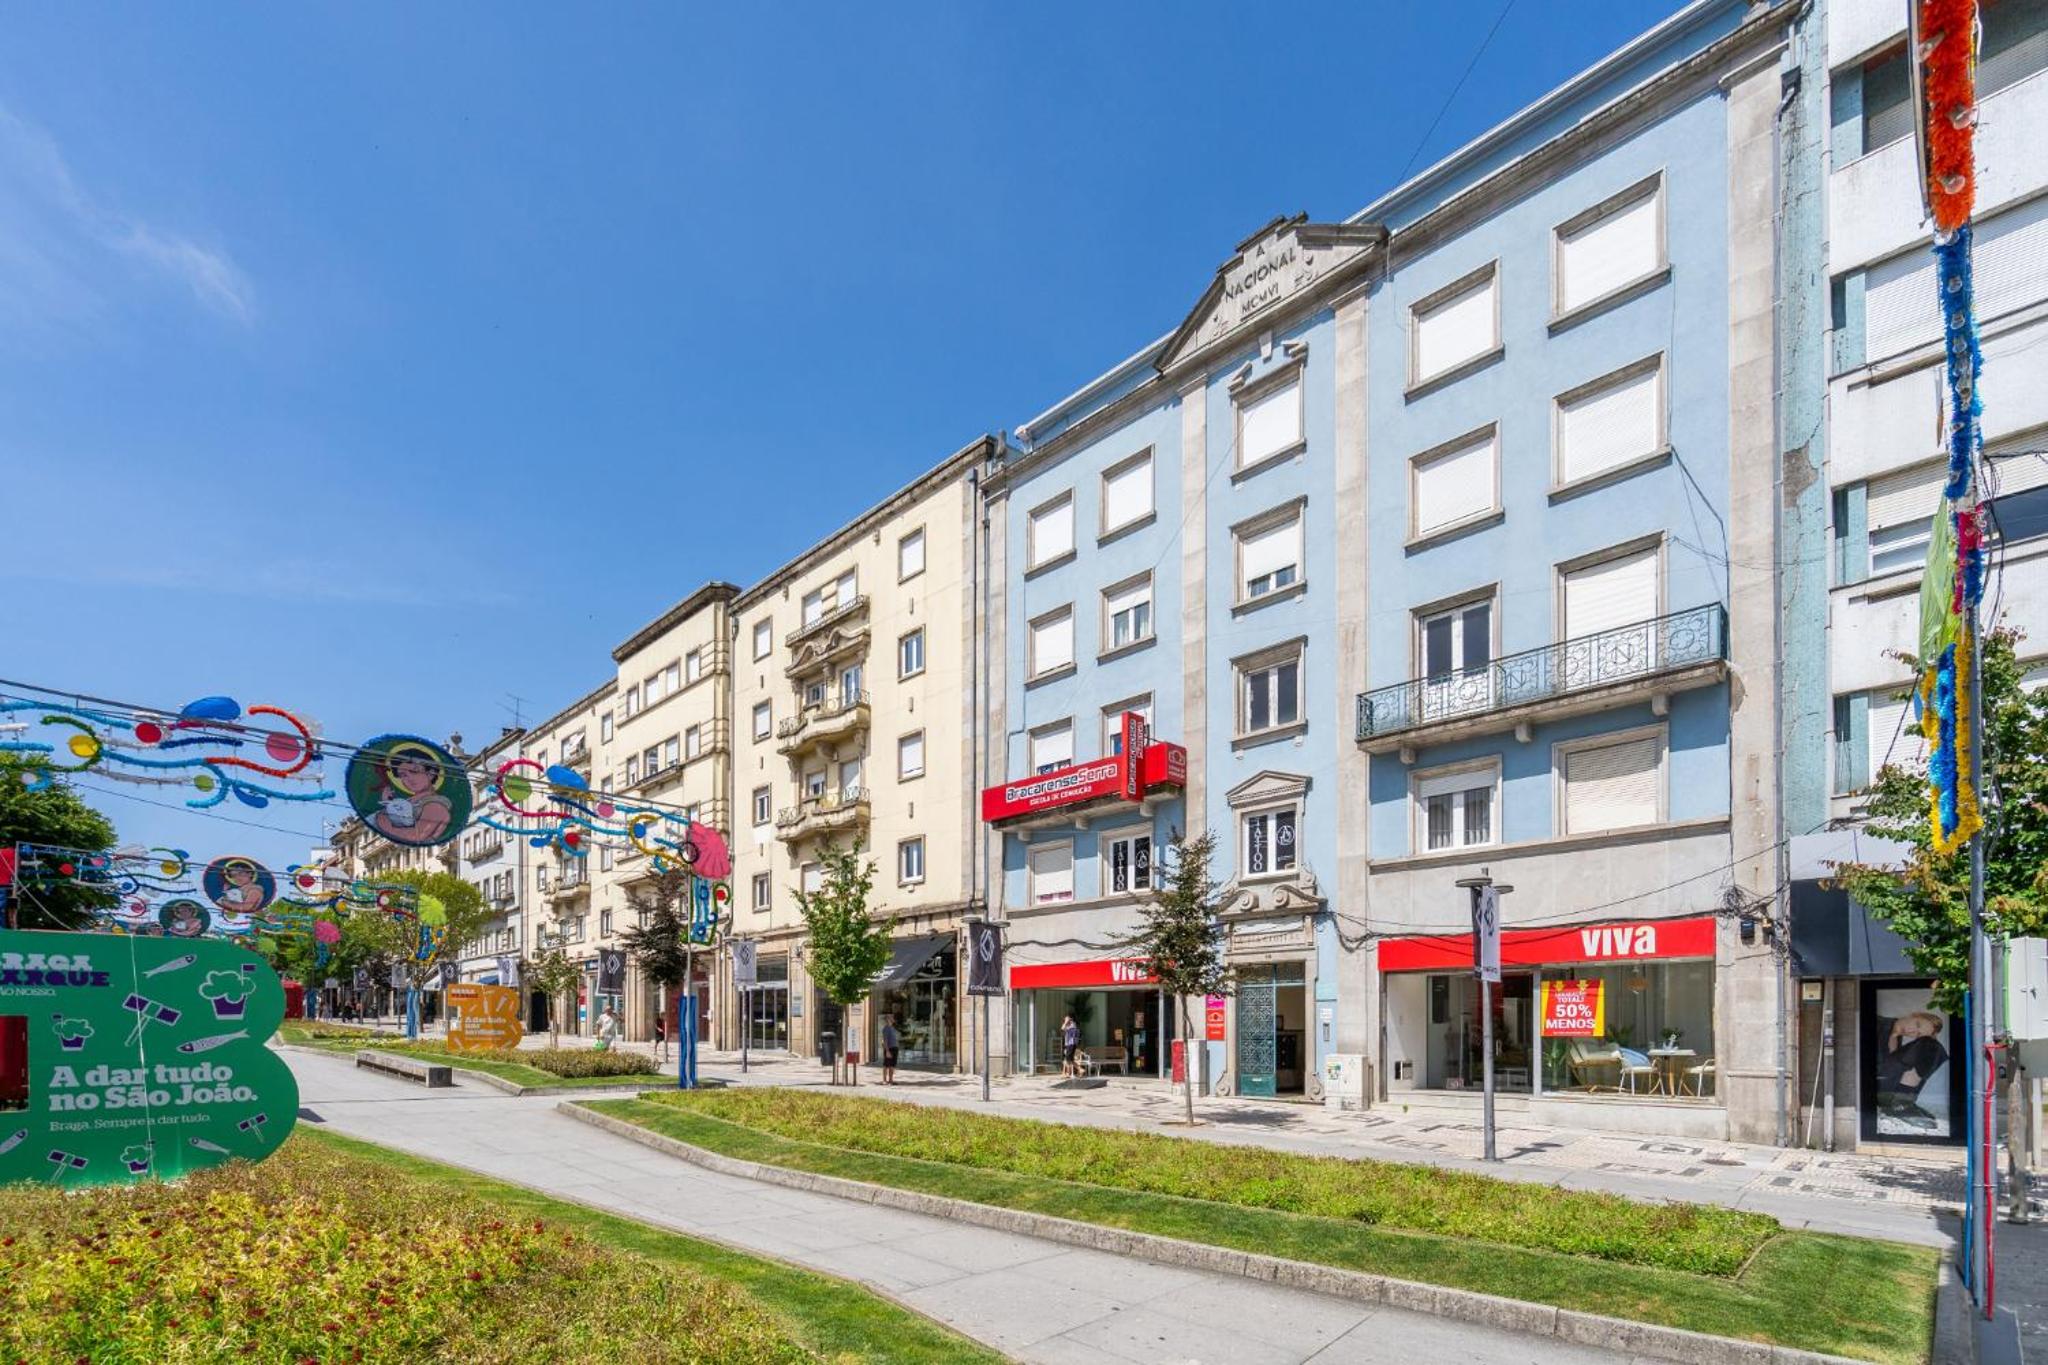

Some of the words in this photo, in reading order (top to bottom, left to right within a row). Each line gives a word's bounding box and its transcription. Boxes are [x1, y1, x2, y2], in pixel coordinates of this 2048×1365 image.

[1256, 243, 1265, 257] A
[1225, 247, 1297, 303] NACIONAL
[1241, 282, 1279, 315] MCMVI
[0, 952, 94, 972] RAGA
[0, 969, 110, 988] ARQUE
[1555, 1003, 1593, 1018] 50%
[1546, 1018, 1597, 1030] MENOS
[49, 1066, 80, 1088] A
[85, 1064, 149, 1086] dar
[154, 1062, 233, 1084] tudo
[49, 1091, 99, 1111] no
[105, 1086, 171, 1109] São
[175, 1082, 258, 1106] João.
[94, 1117, 146, 1130] Sempre
[157, 1114, 179, 1125] dar
